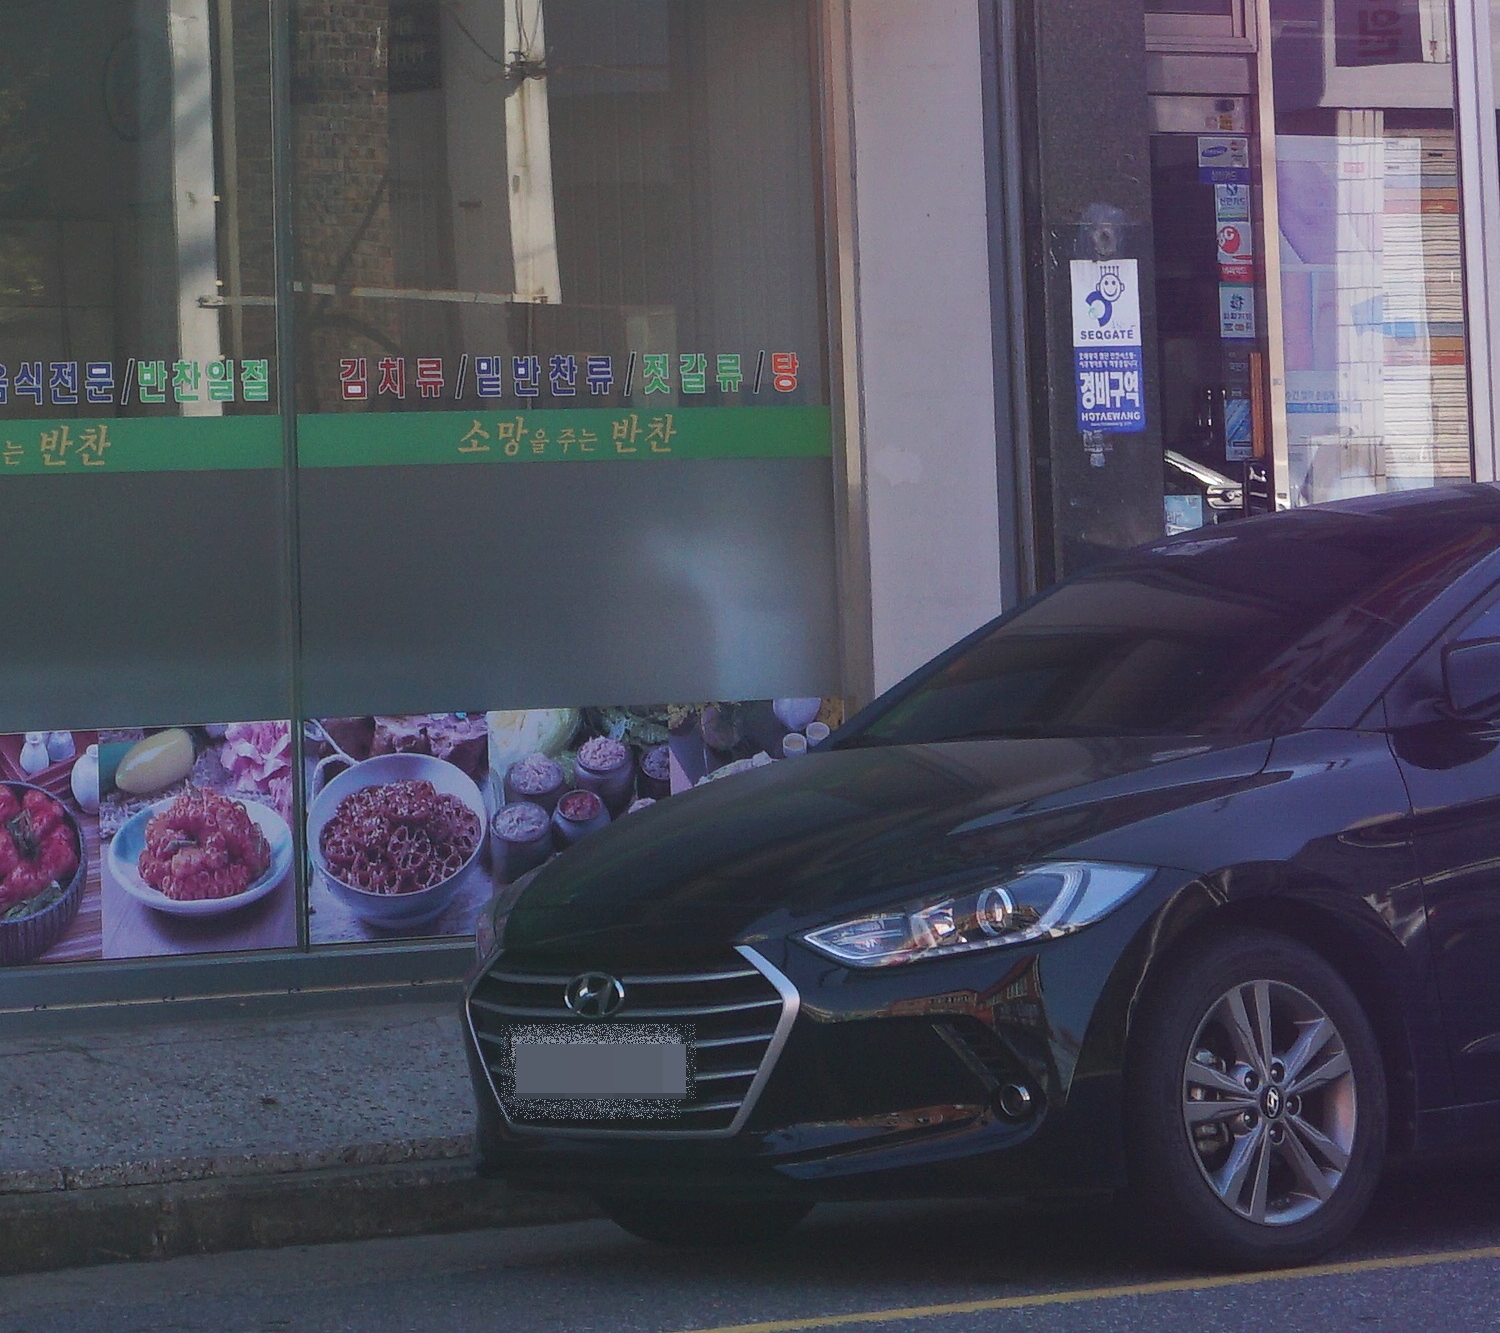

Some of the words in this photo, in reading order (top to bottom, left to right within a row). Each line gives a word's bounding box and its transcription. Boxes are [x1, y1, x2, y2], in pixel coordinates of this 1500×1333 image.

[1080, 370, 1140, 410] 경비구역
[39, 424, 112, 467] 반찬
[457, 415, 550, 457] 소망을
[556, 426, 599, 454] 주는
[611, 413, 677, 454] 반찬
